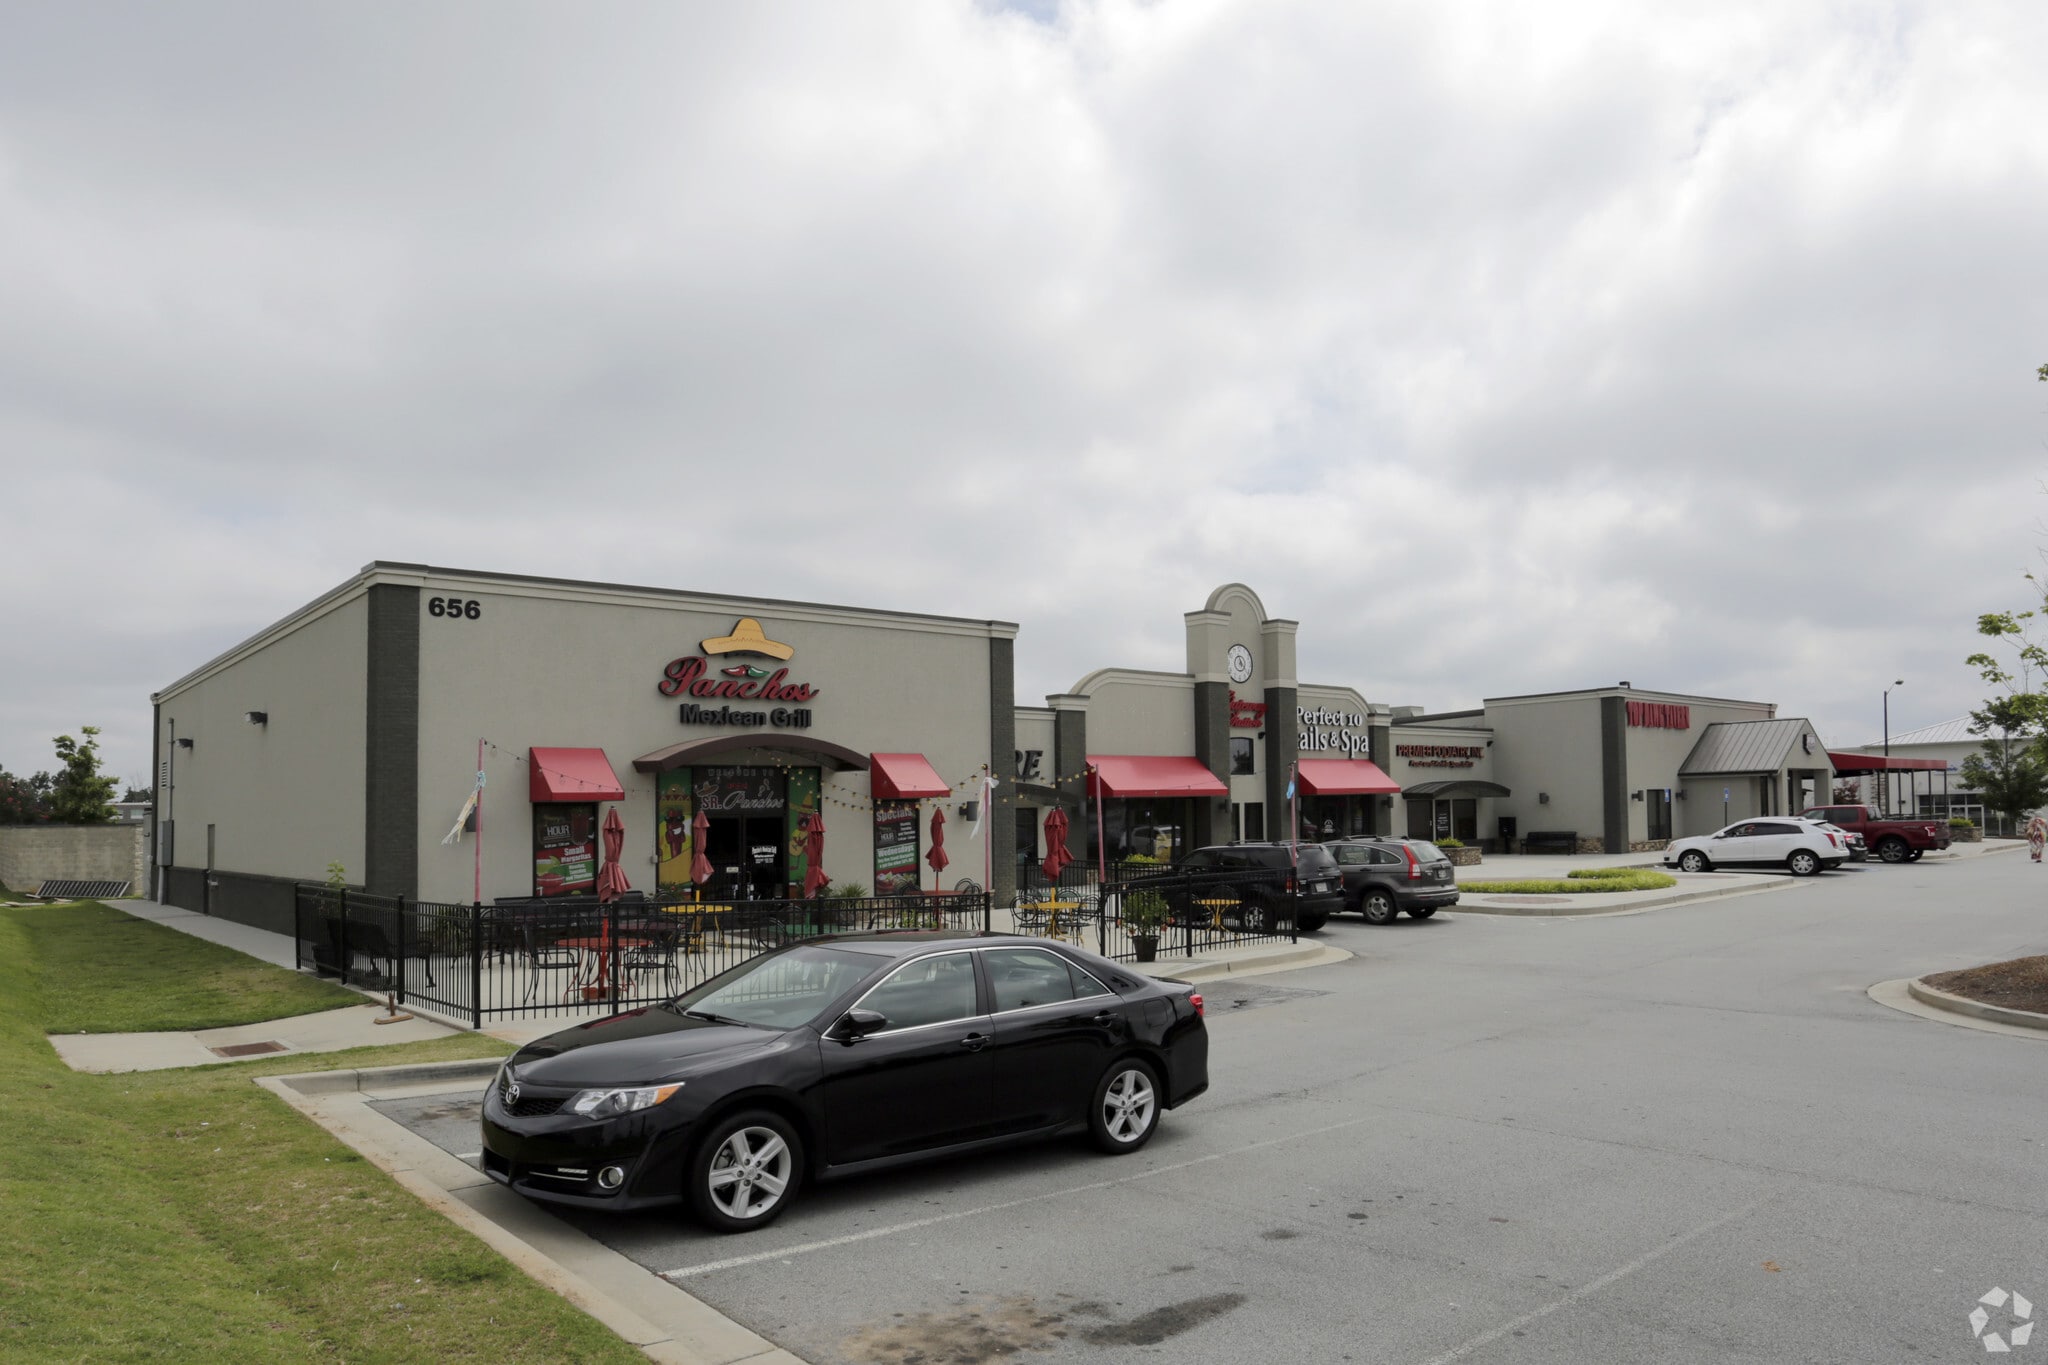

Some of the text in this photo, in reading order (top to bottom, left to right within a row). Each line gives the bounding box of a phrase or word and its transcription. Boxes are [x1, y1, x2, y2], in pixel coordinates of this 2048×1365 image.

[429, 597, 481, 620] 656
[658, 655, 820, 703] Panchos
[680, 703, 812, 728] Mexican Grill
[1297, 706, 1363, 727] Perfect 10
[1298, 726, 1369, 760] ails & Spa
[701, 795, 723, 810] SR.
[546, 824, 570, 837] HOUR
[564, 845, 585, 857] Small
